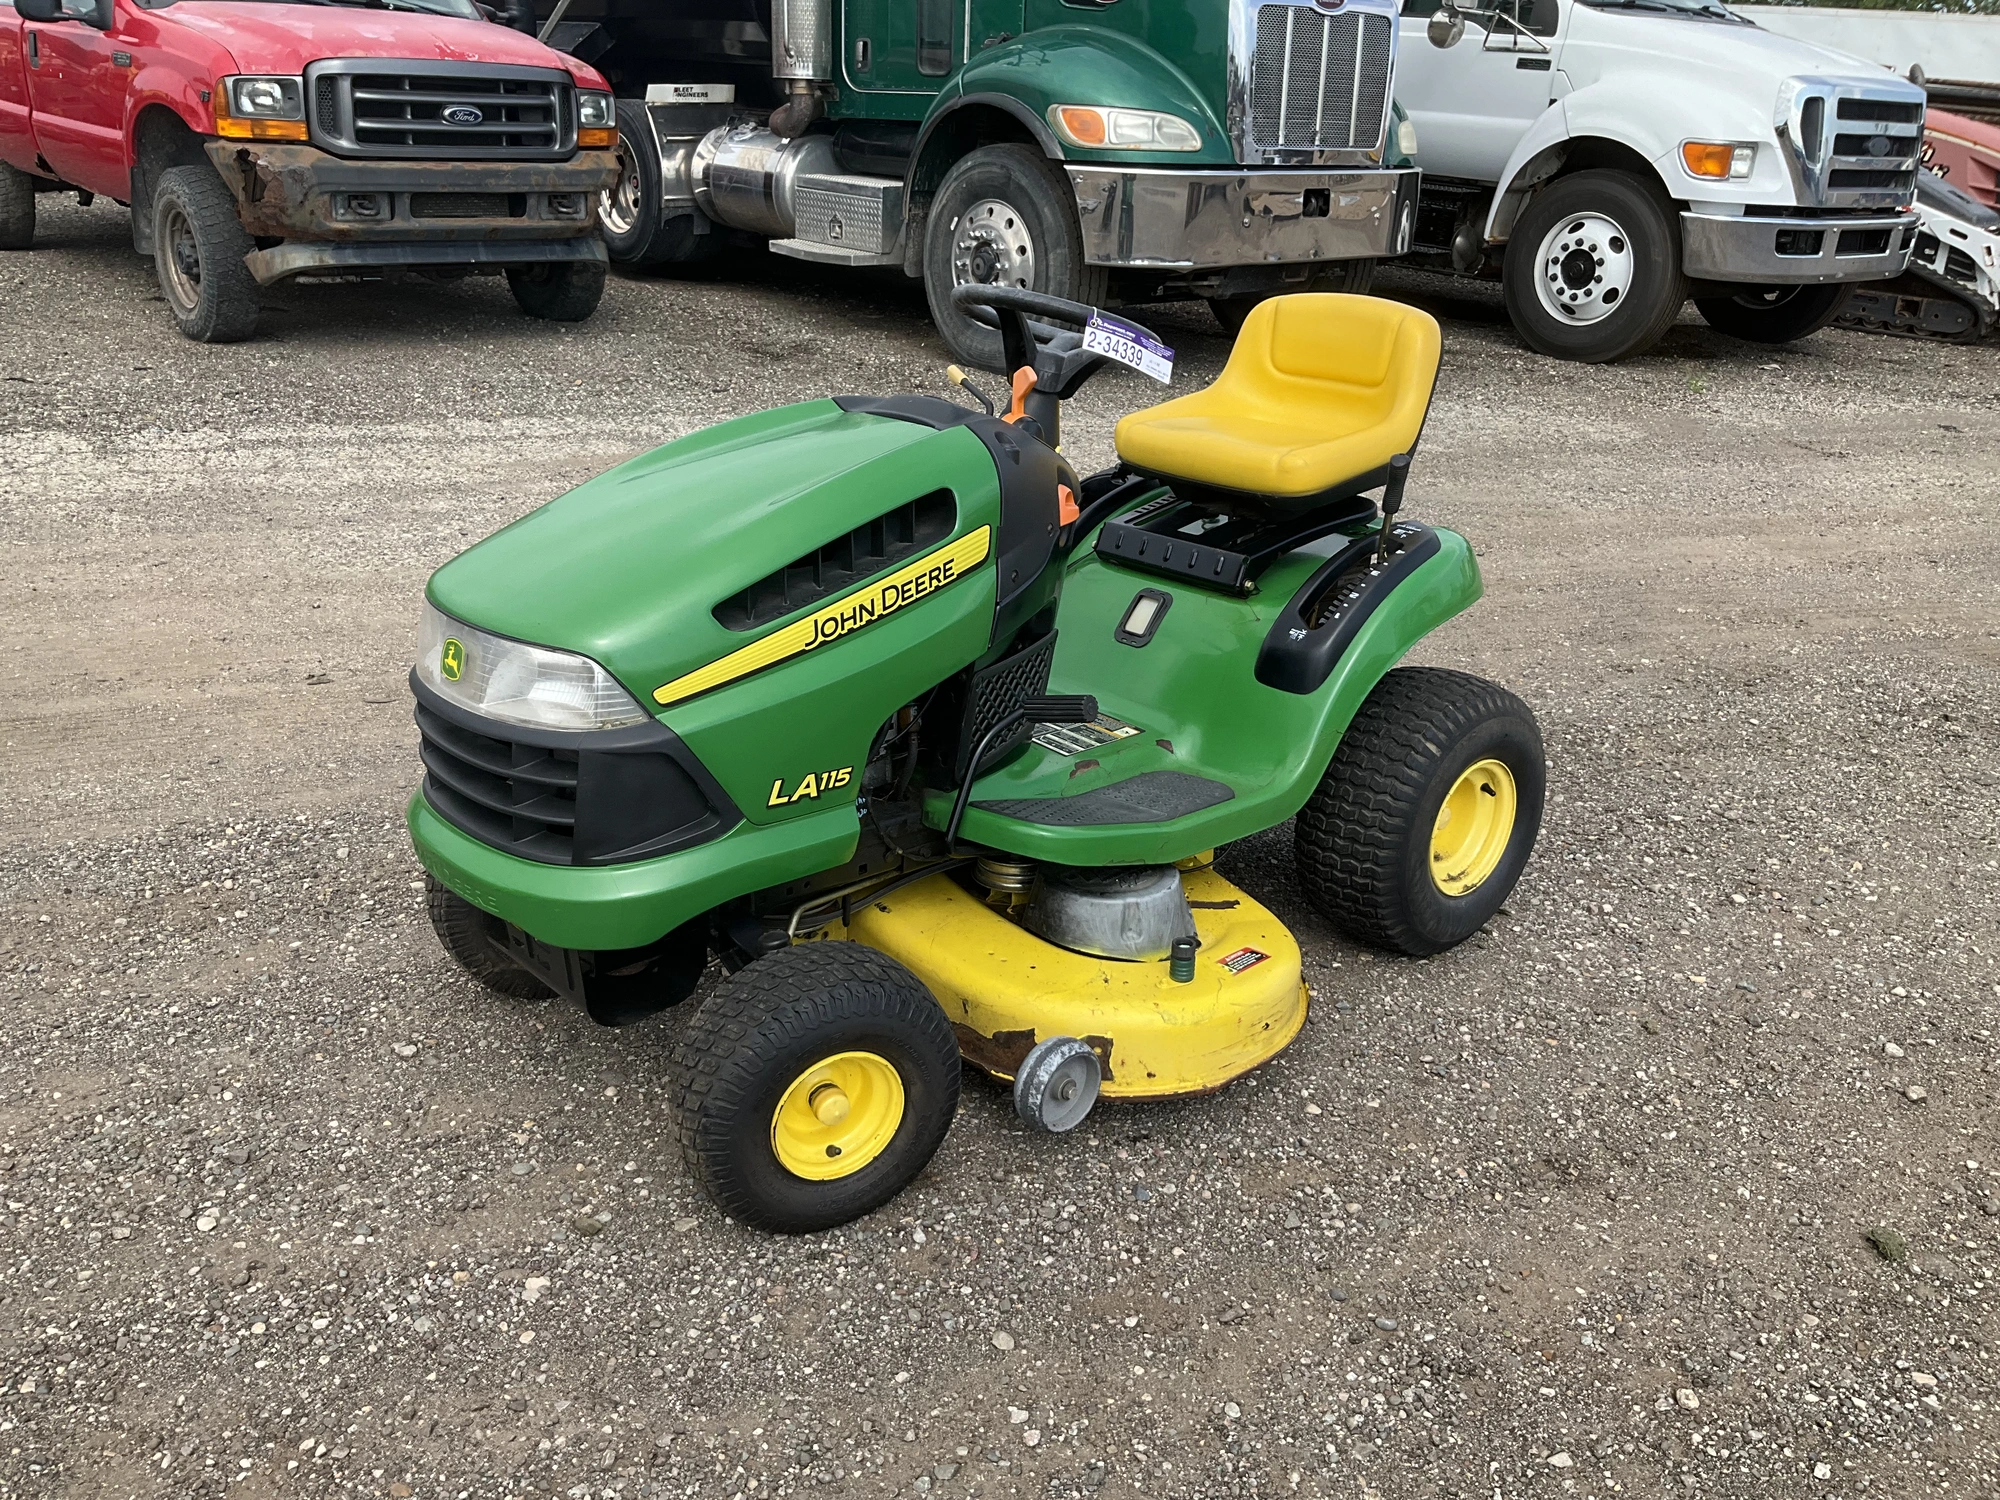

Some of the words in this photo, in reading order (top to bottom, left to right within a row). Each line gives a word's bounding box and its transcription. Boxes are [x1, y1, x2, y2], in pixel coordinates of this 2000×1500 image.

[1087, 331, 1143, 366] 2-34339
[804, 597, 876, 647] JOHN
[881, 558, 955, 611] DEERE
